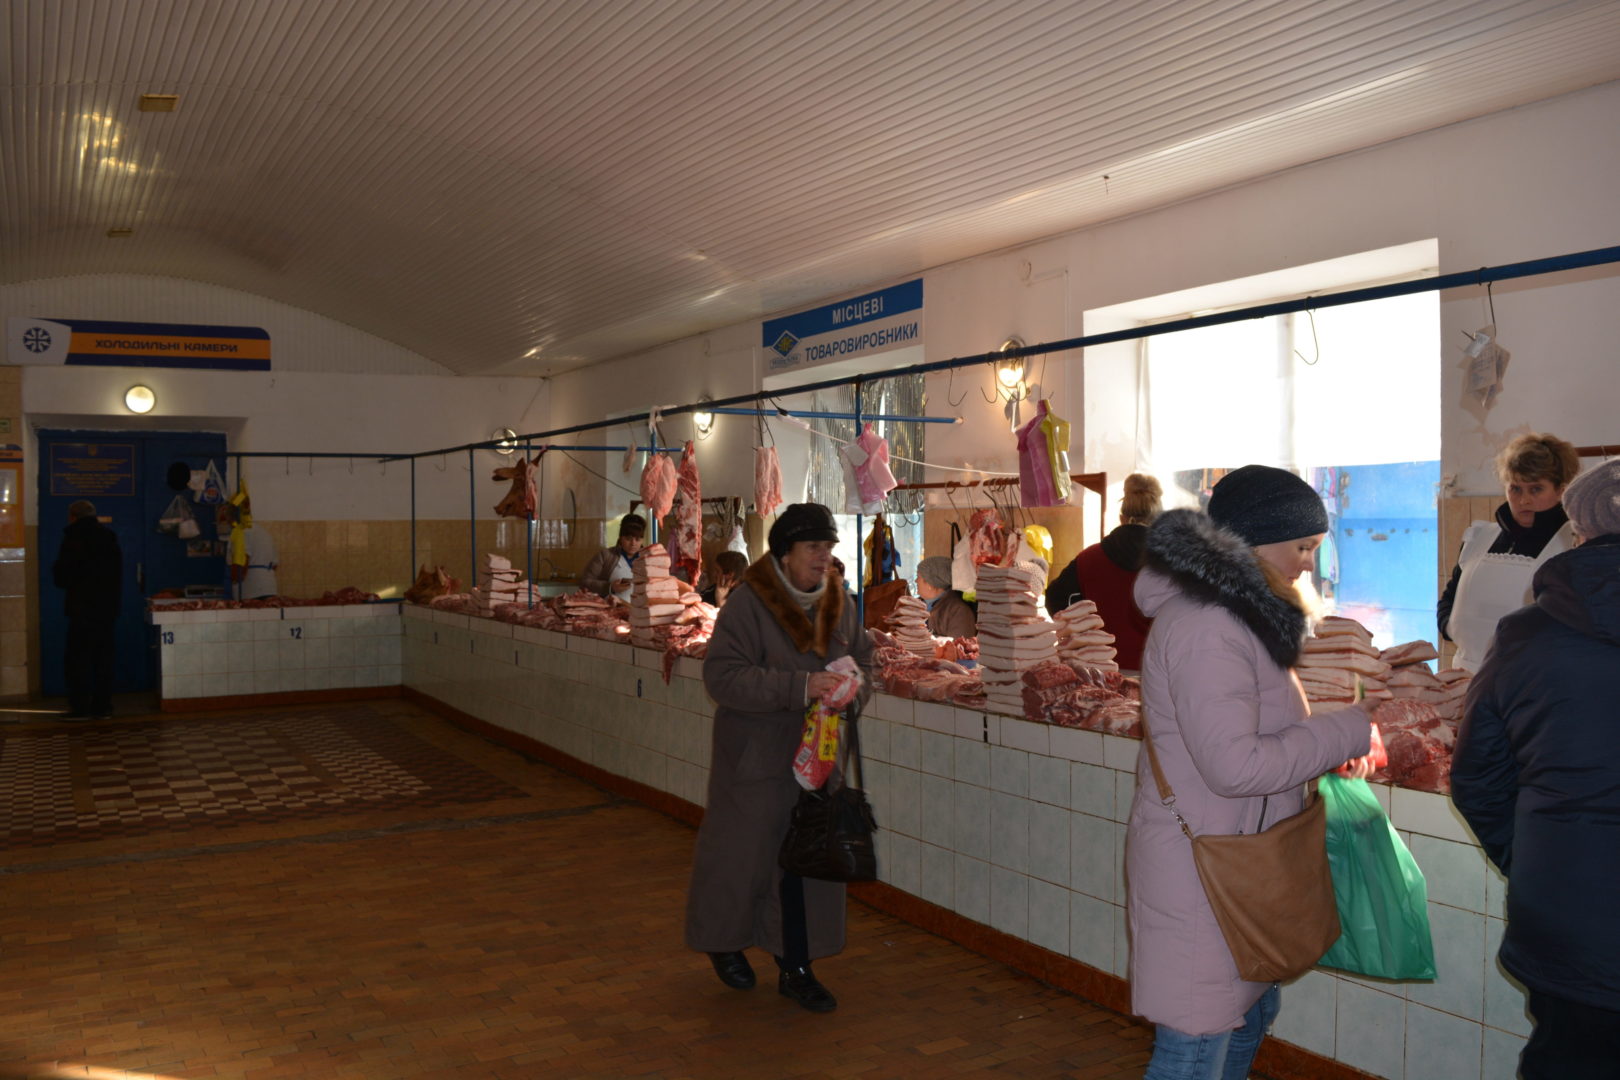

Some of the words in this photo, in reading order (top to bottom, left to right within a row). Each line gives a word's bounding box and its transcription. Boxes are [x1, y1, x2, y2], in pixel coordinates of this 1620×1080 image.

[832, 296, 884, 325] МІСЦЕВІ
[96, 339, 180, 351] ХОЛОДИЛЬНІ
[184, 342, 238, 353] КАМЕРИ
[805, 322, 918, 362] ТОВАРОВИРОБНИКИ
[162, 632, 174, 645] 13
[290, 627, 302, 640] 12
